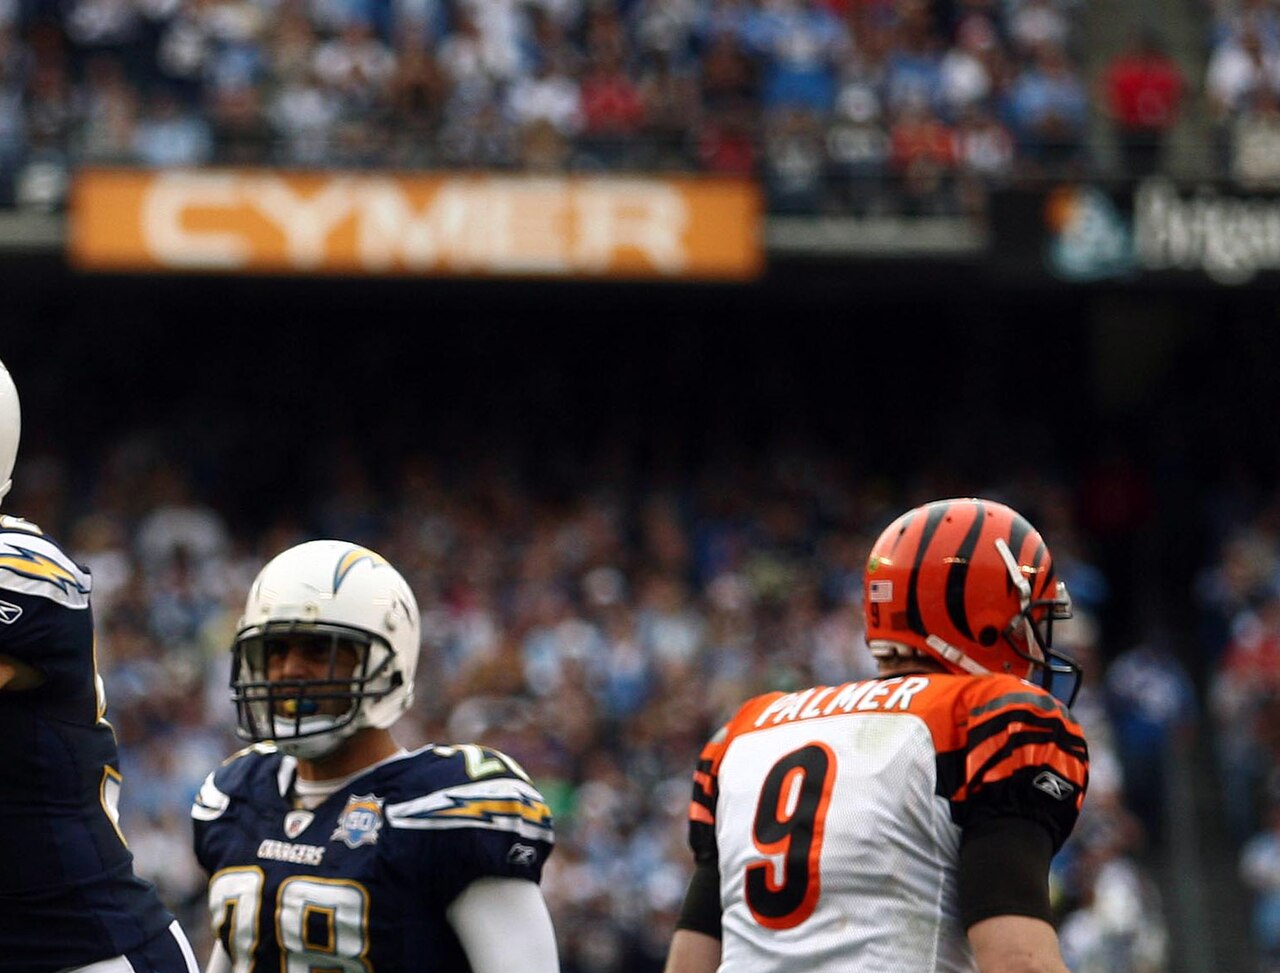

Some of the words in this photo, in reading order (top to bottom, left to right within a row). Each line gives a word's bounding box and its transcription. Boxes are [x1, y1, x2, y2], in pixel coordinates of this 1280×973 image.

[139, 170, 691, 275] CYMER
[754, 676, 929, 728] PALMER
[745, 740, 837, 930] 9
